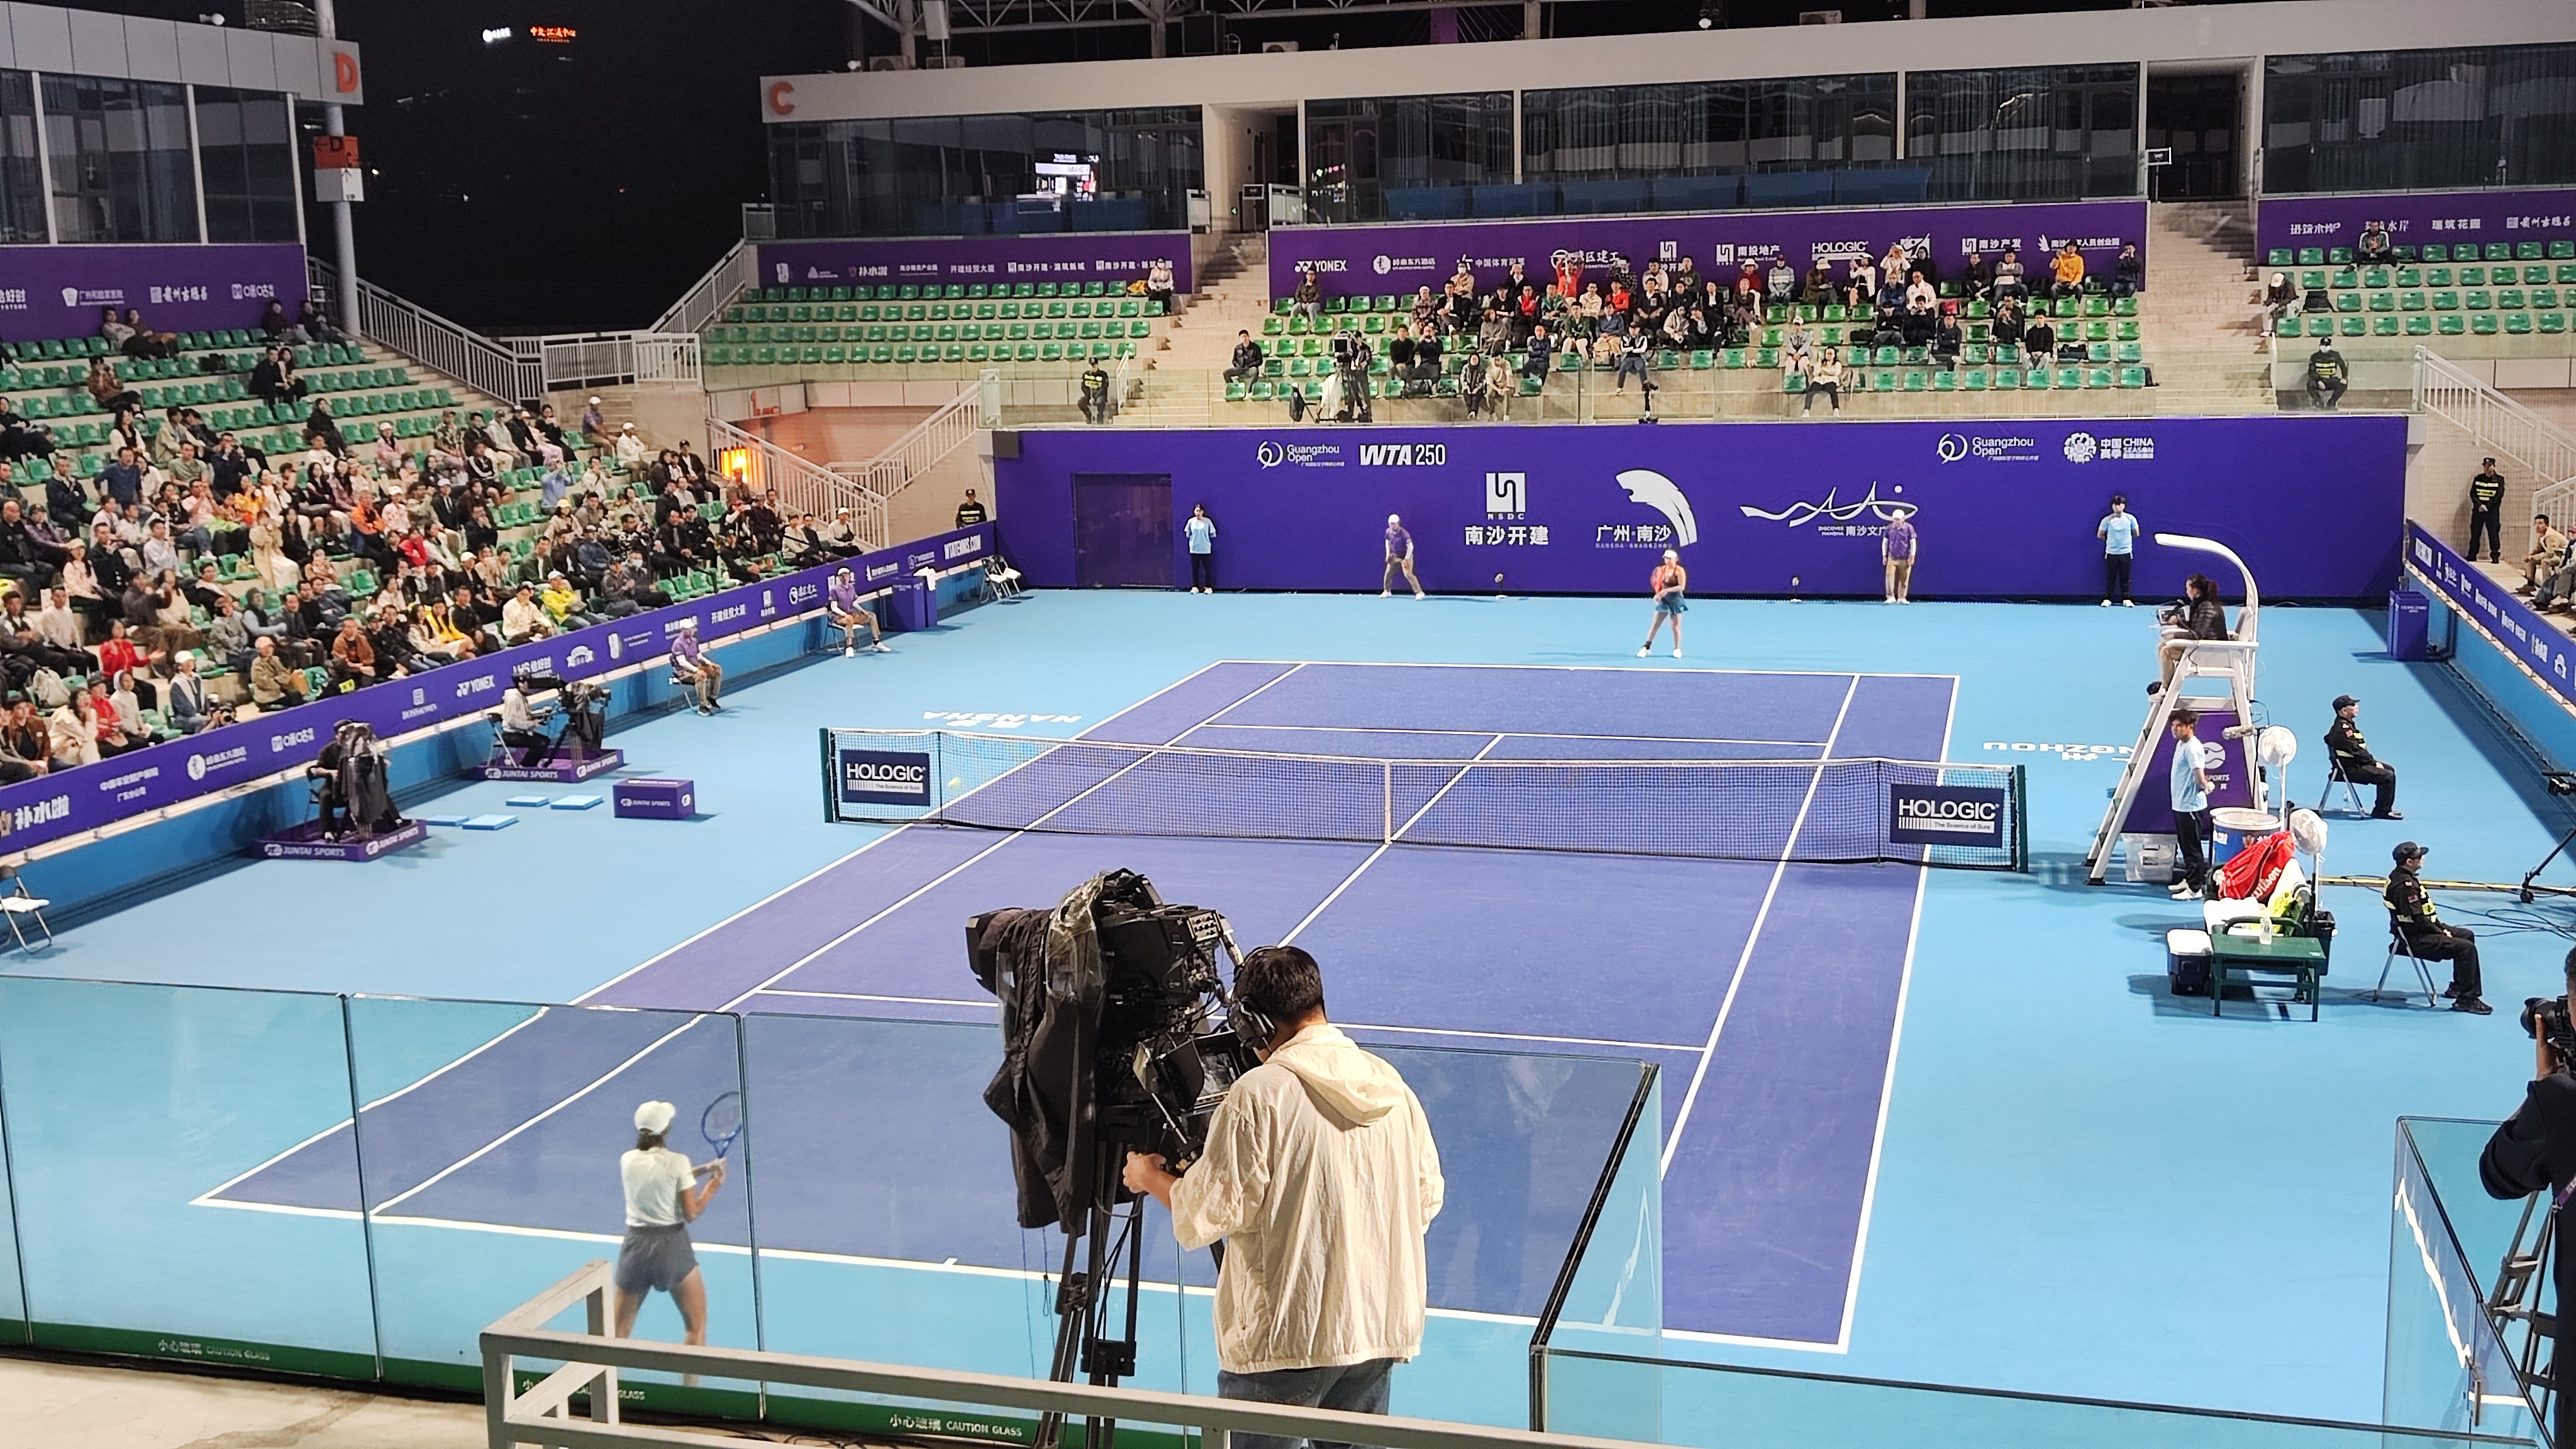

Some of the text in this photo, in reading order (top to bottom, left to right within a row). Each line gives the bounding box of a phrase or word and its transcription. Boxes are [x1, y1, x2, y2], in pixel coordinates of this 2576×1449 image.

[334, 52, 359, 93] D
[769, 81, 795, 115] C
[1811, 241, 1867, 253] HOLOGIC
[1979, 238, 2021, 249] 南沙产发
[2051, 238, 2120, 248] 南沙人员创业园
[1737, 244, 1780, 257] 南投地产
[1314, 259, 1347, 272] YONEX
[1972, 437, 2034, 447] Guangzhou
[2123, 438, 2153, 447] CHINA
[1286, 444, 1340, 455] Guangzhou
[1360, 444, 1446, 465] WTA 250
[1972, 447, 2002, 457] Open
[1287, 453, 1313, 464] Open
[1465, 525, 1549, 545] 南沙开建
[1596, 525, 1672, 543] 广州·南沙
[944, 535, 981, 560] WTATENNIS.COM
[470, 675, 496, 693] YONEX
[502, 769, 558, 779] JUNTAI SPORTS
[846, 763, 924, 782] HOLOGIC
[1898, 799, 1996, 820] HOLOGIC
[399, 827, 419, 841] SPORTS
[283, 846, 345, 857] JUNTAI SPORTS
[2251, 867, 2282, 899] Wilson
[158, 1339, 270, 1361] 小心玻璃 CAUTION GLASS
[617, 1389, 645, 1400] GLASS
[890, 1414, 1023, 1437] 小心玻璃 CAUTION GLASS
